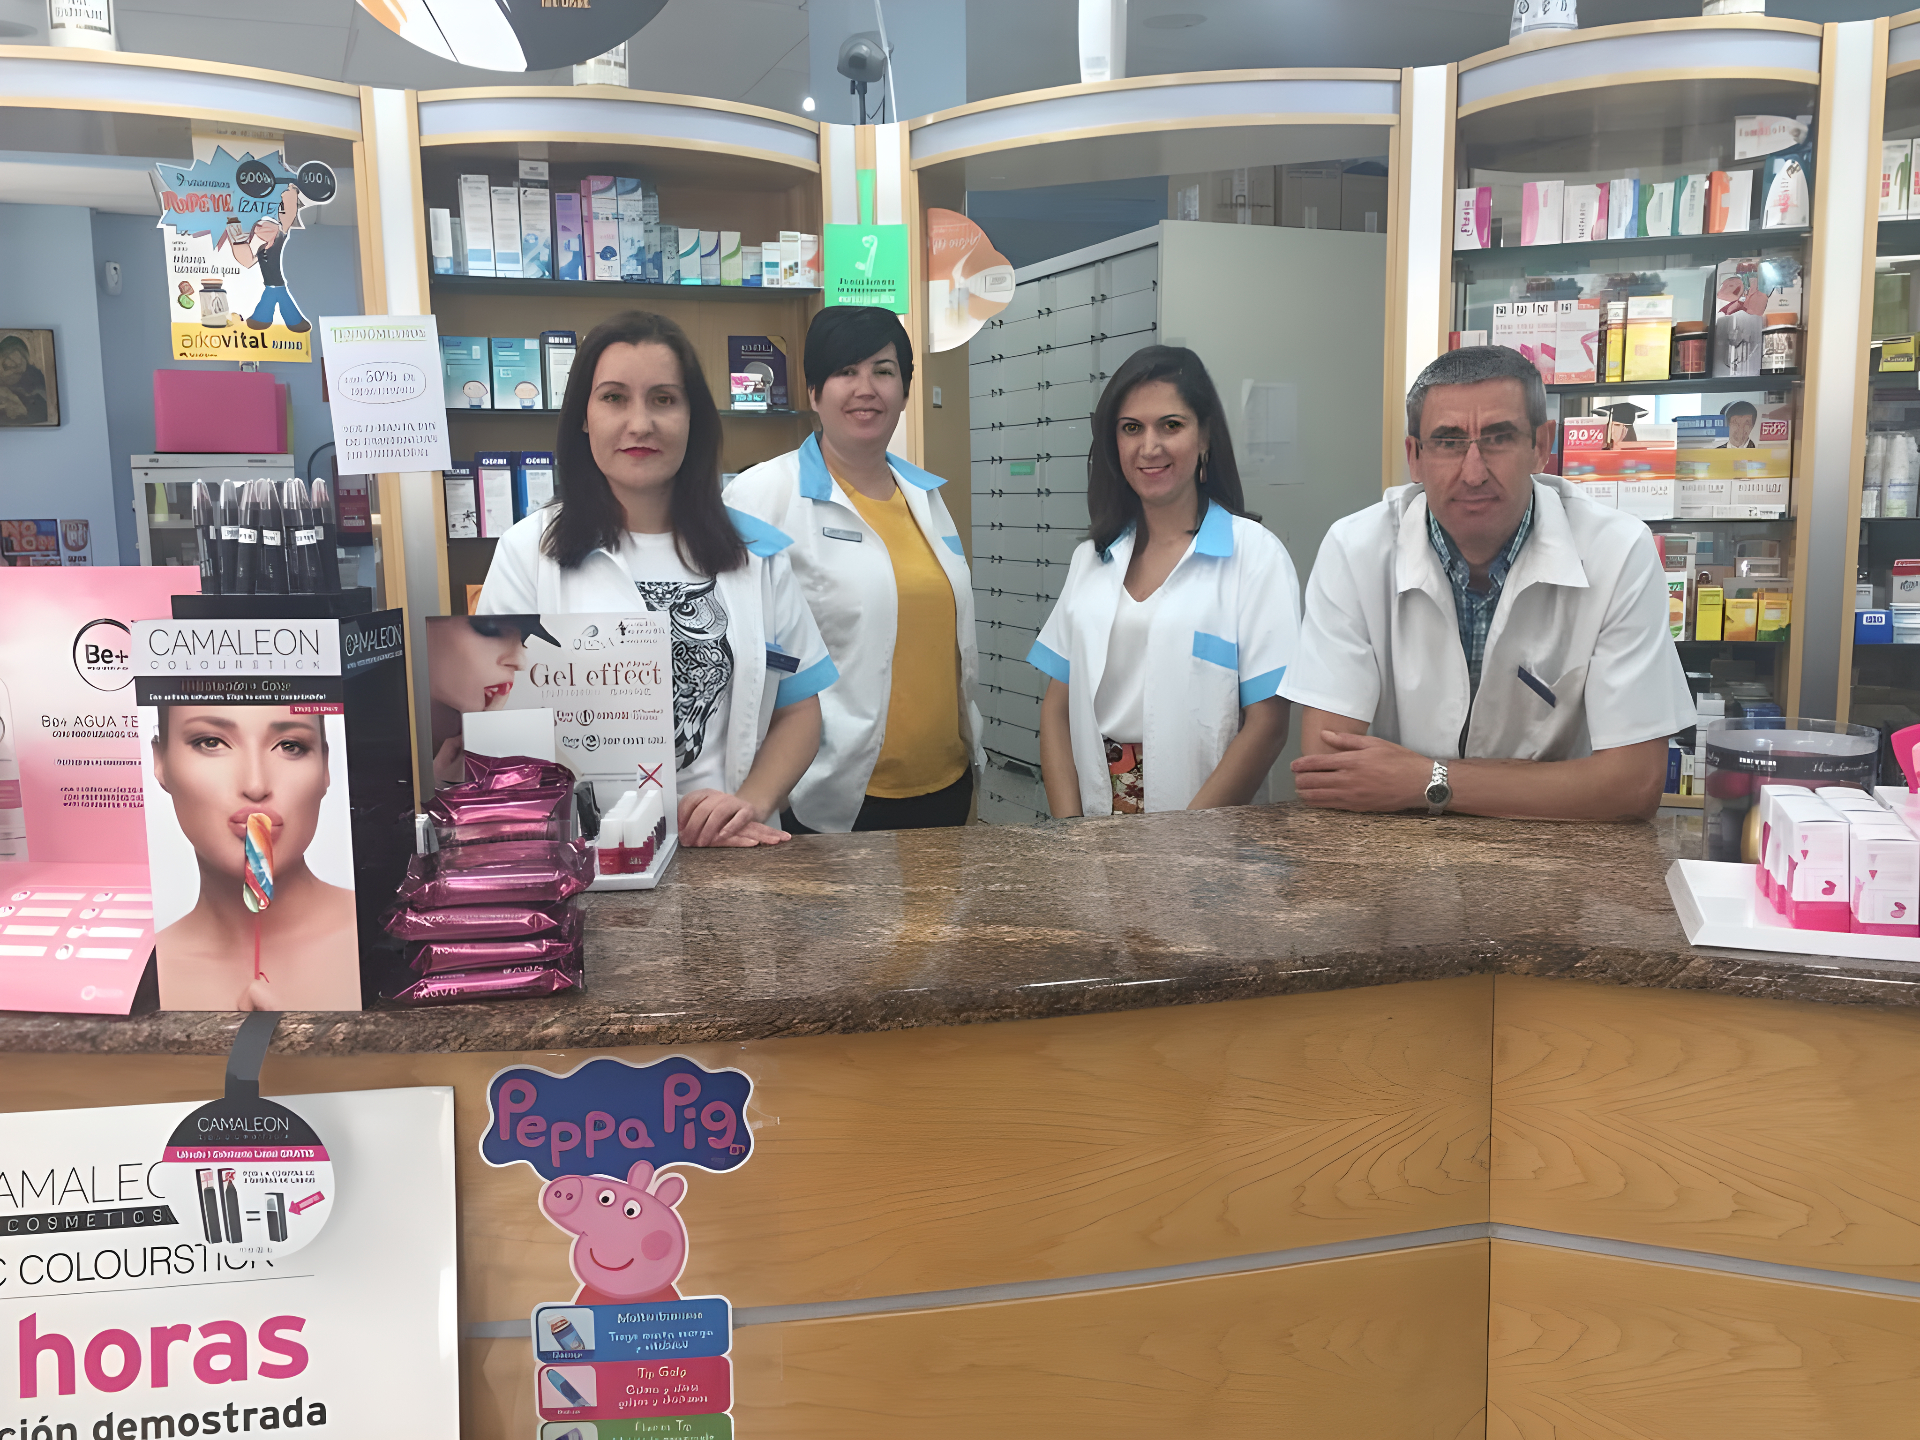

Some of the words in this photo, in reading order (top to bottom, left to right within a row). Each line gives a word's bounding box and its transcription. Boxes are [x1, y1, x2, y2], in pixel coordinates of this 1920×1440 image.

[148, 628, 320, 656] CAMALEON
[530, 662, 577, 688] Gel
[586, 660, 662, 686] effect
[74, 714, 117, 728] AGUA
[197, 1116, 290, 1132] CAMALEON
[498, 1078, 656, 1167] Peppa
[663, 1073, 738, 1149] Pig
[18, 1311, 309, 1399] horas
[92, 1396, 327, 1440] demostrada
